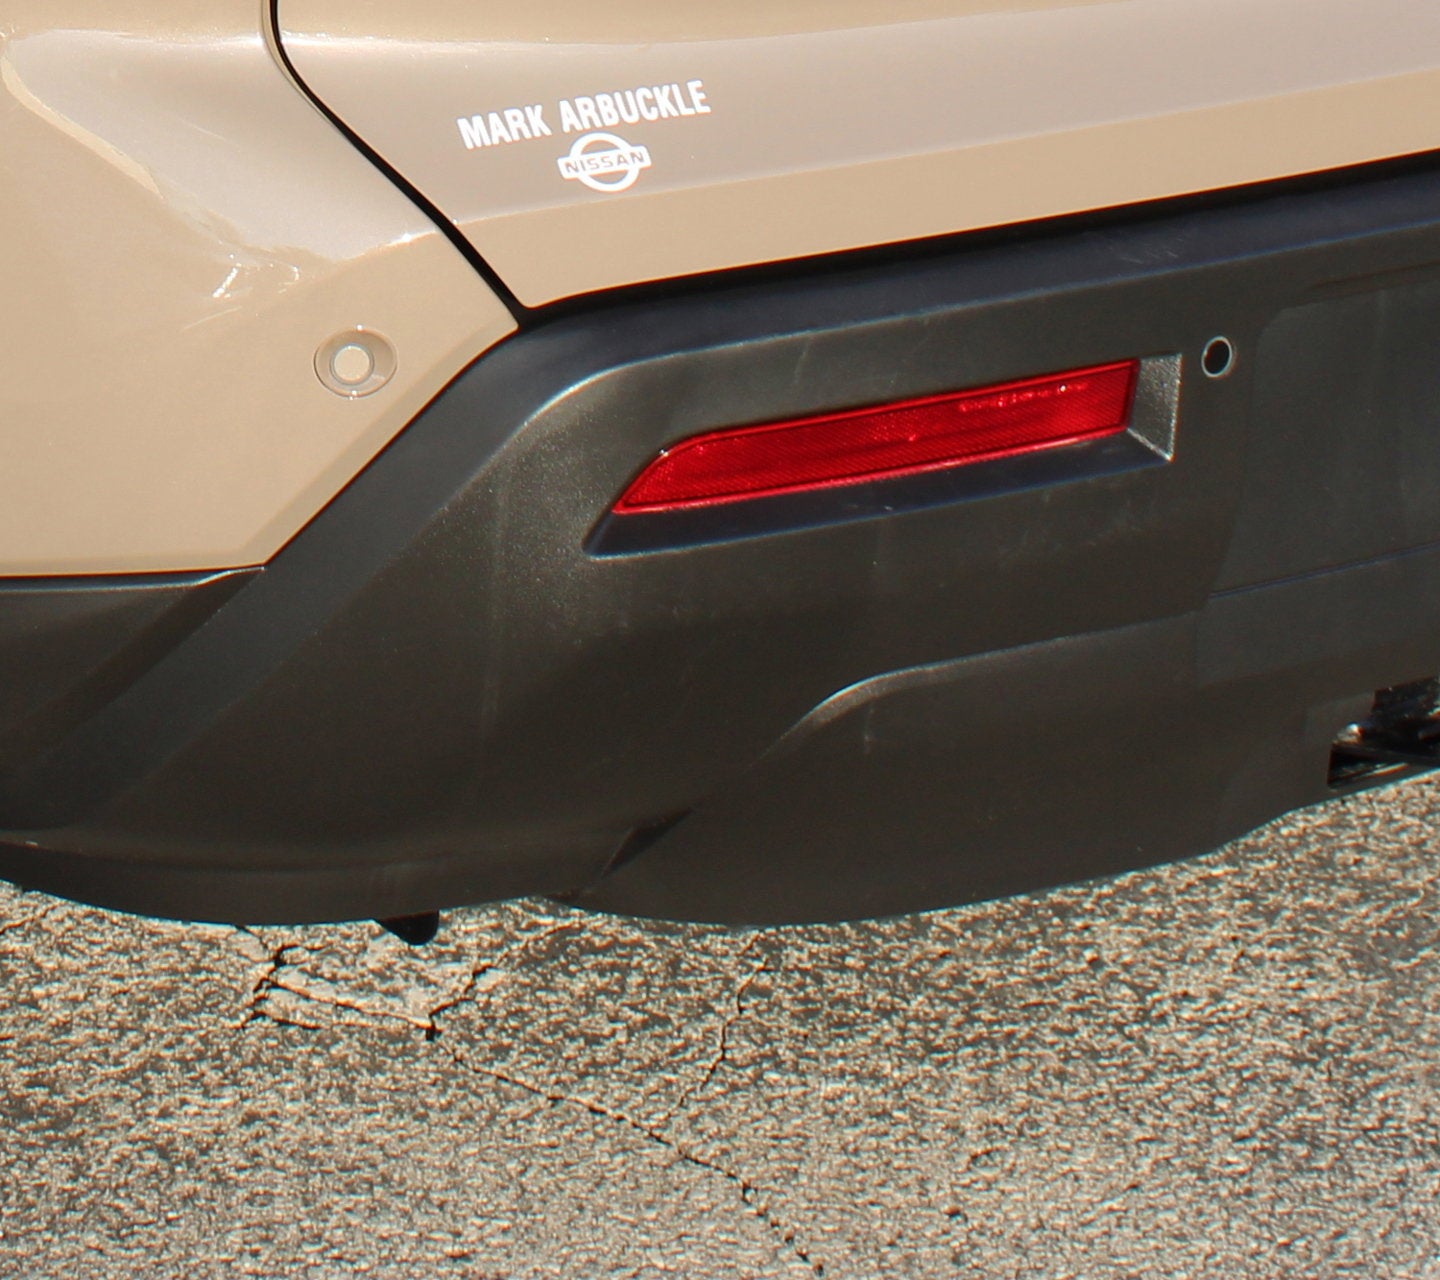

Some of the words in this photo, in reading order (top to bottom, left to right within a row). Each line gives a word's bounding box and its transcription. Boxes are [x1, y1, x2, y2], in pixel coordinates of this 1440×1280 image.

[456, 104, 552, 150] MARK
[559, 79, 712, 134] ARBUCKLE
[563, 150, 646, 175] NISSAN
